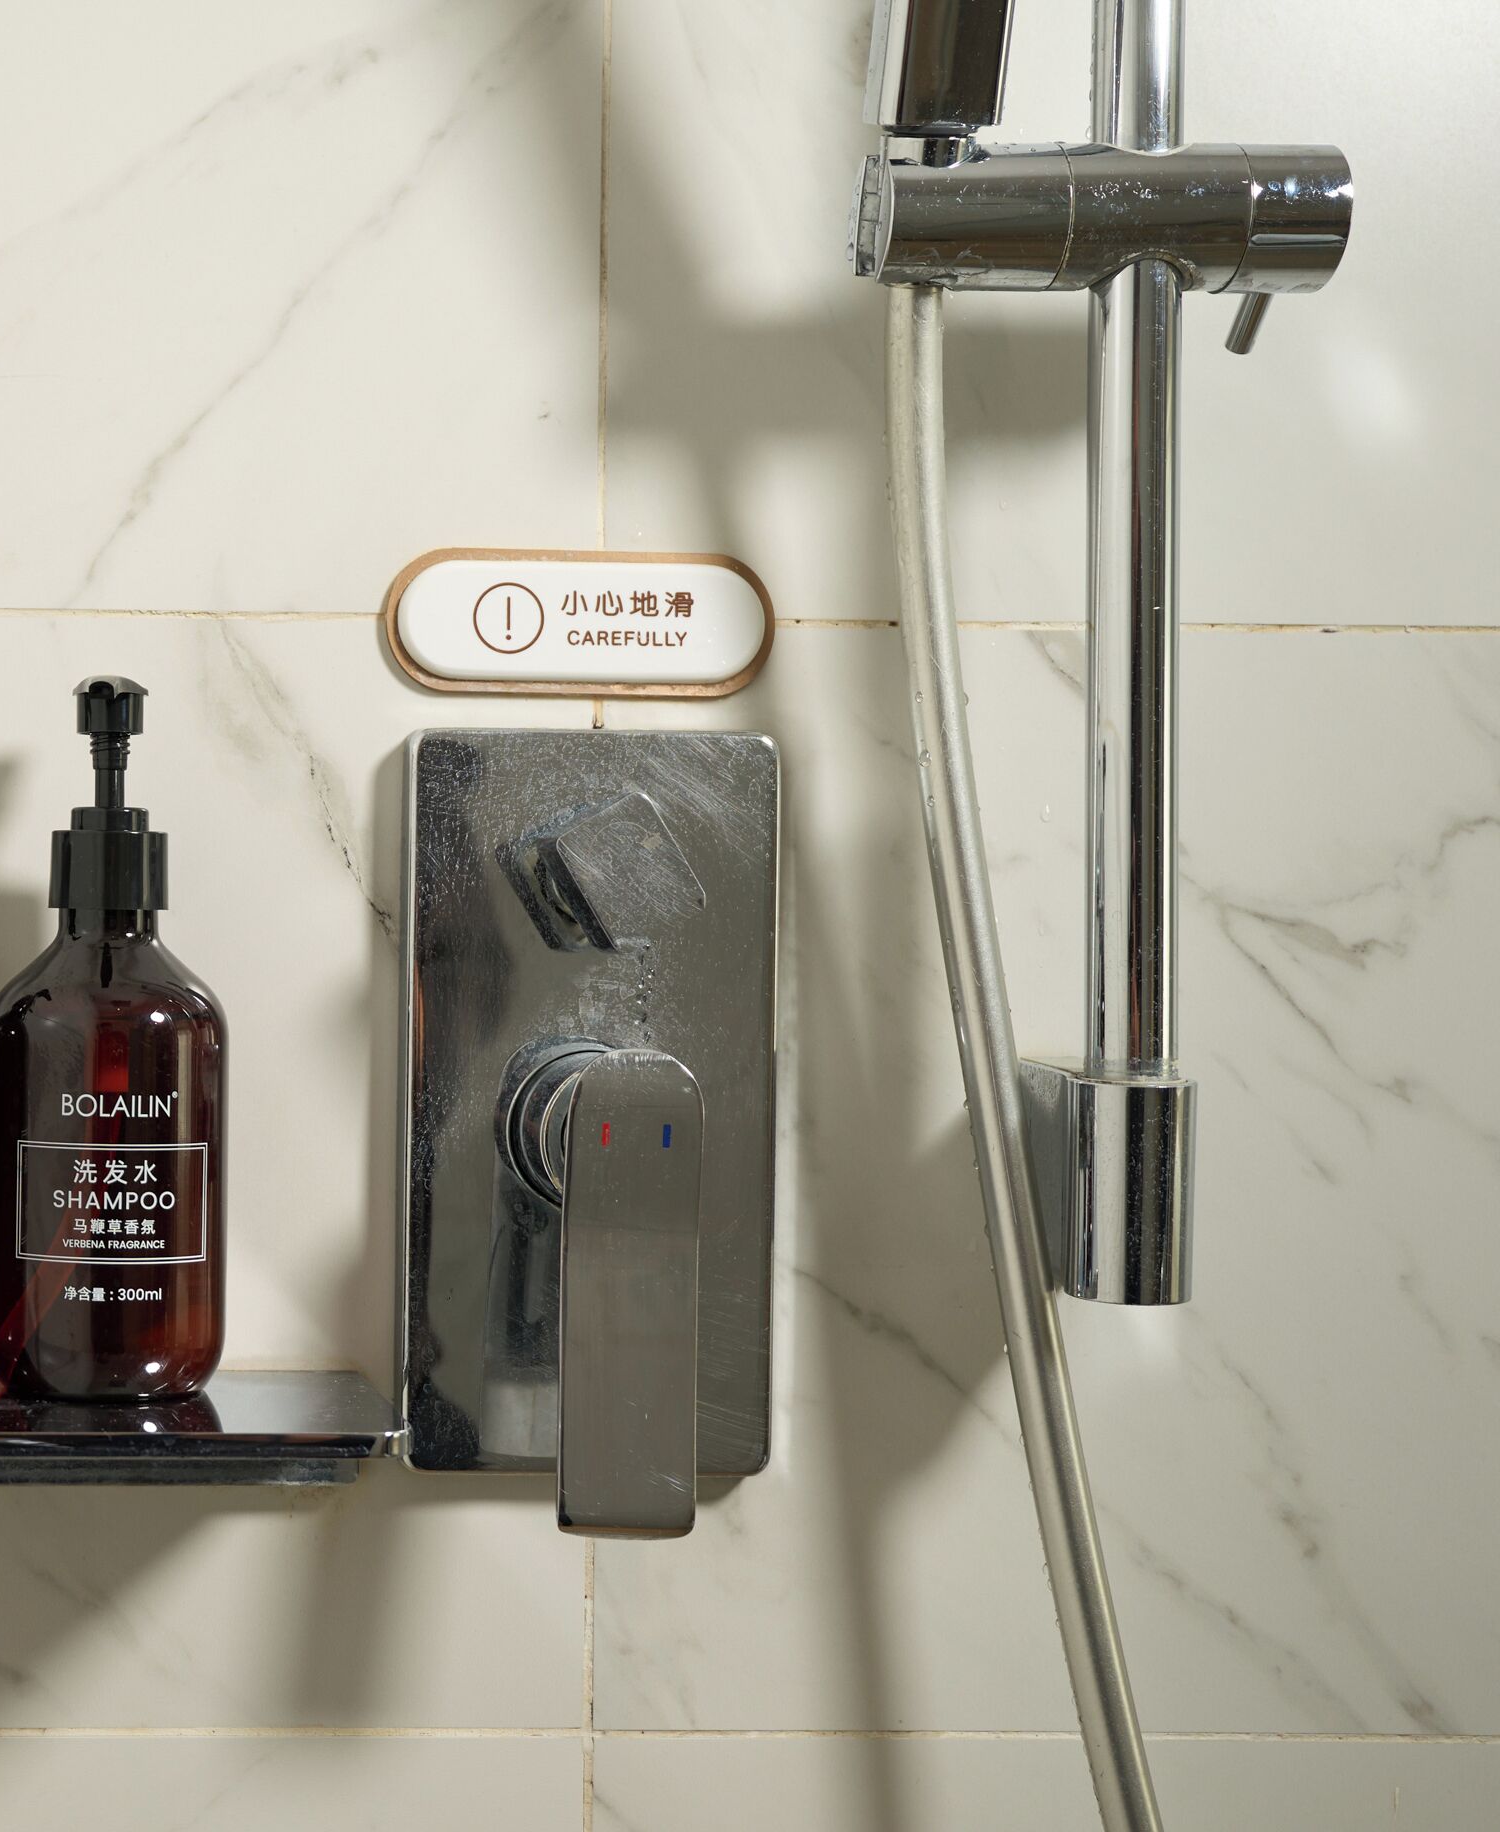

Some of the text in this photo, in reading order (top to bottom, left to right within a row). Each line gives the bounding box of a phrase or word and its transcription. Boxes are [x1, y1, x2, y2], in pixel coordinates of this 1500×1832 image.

[561, 590, 695, 618] 小心地滑
[566, 630, 688, 647] CAREFULLY
[73, 1158, 158, 1185] 洗发水
[53, 1189, 176, 1210] SHAMPOO
[72, 1218, 156, 1235] 马鞭草香氛
[62, 1238, 165, 1250] VERBENA FRAGRANCE
